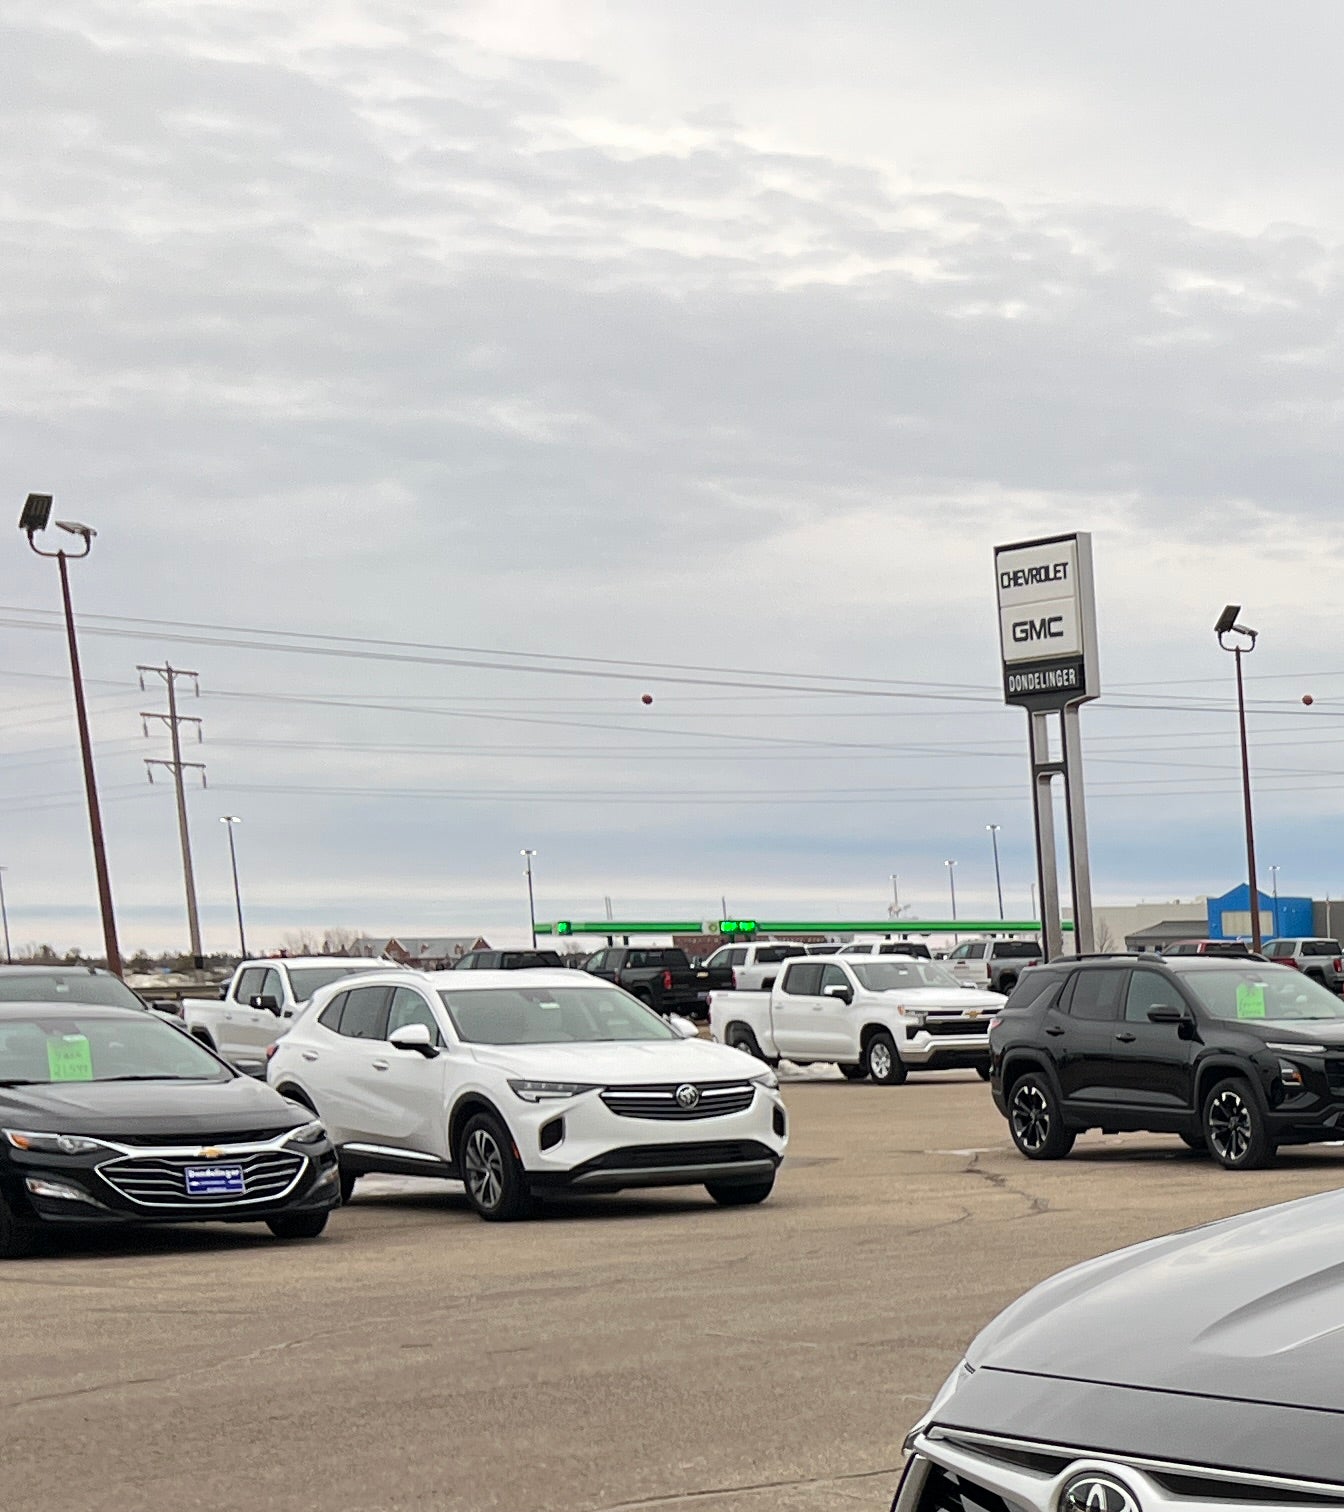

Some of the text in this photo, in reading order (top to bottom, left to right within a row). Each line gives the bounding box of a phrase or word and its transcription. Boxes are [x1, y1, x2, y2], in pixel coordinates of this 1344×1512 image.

[1000, 562, 1069, 589] CHEVROLET
[1012, 616, 1064, 642] GMC
[1008, 668, 1076, 692] DONDELINGER
